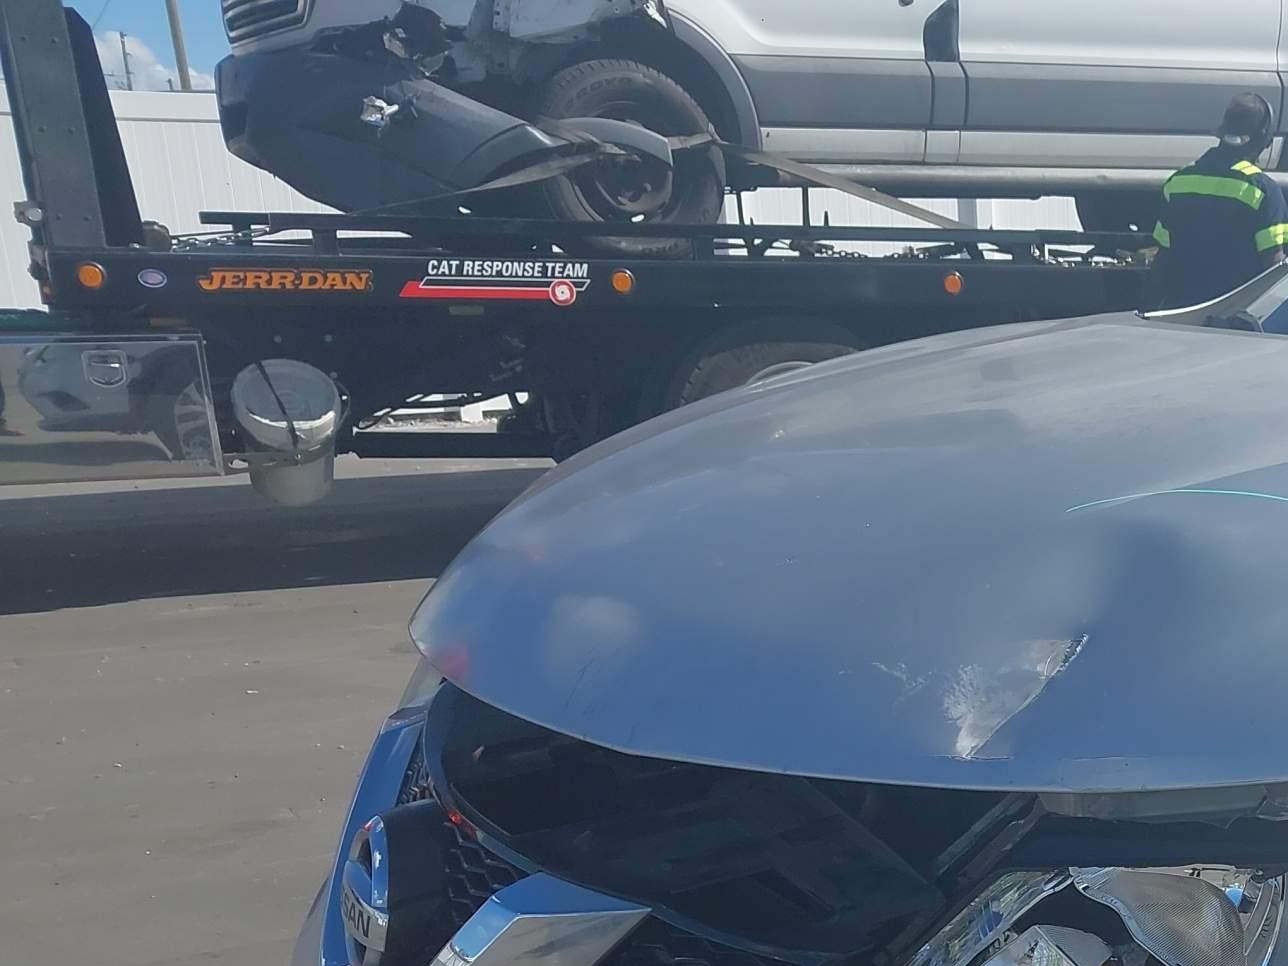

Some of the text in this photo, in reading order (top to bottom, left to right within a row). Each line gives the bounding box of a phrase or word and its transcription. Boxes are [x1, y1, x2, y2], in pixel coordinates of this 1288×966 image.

[427, 259, 588, 280] CAT RESPONSE TEAM
[342, 893, 370, 938] SAN
